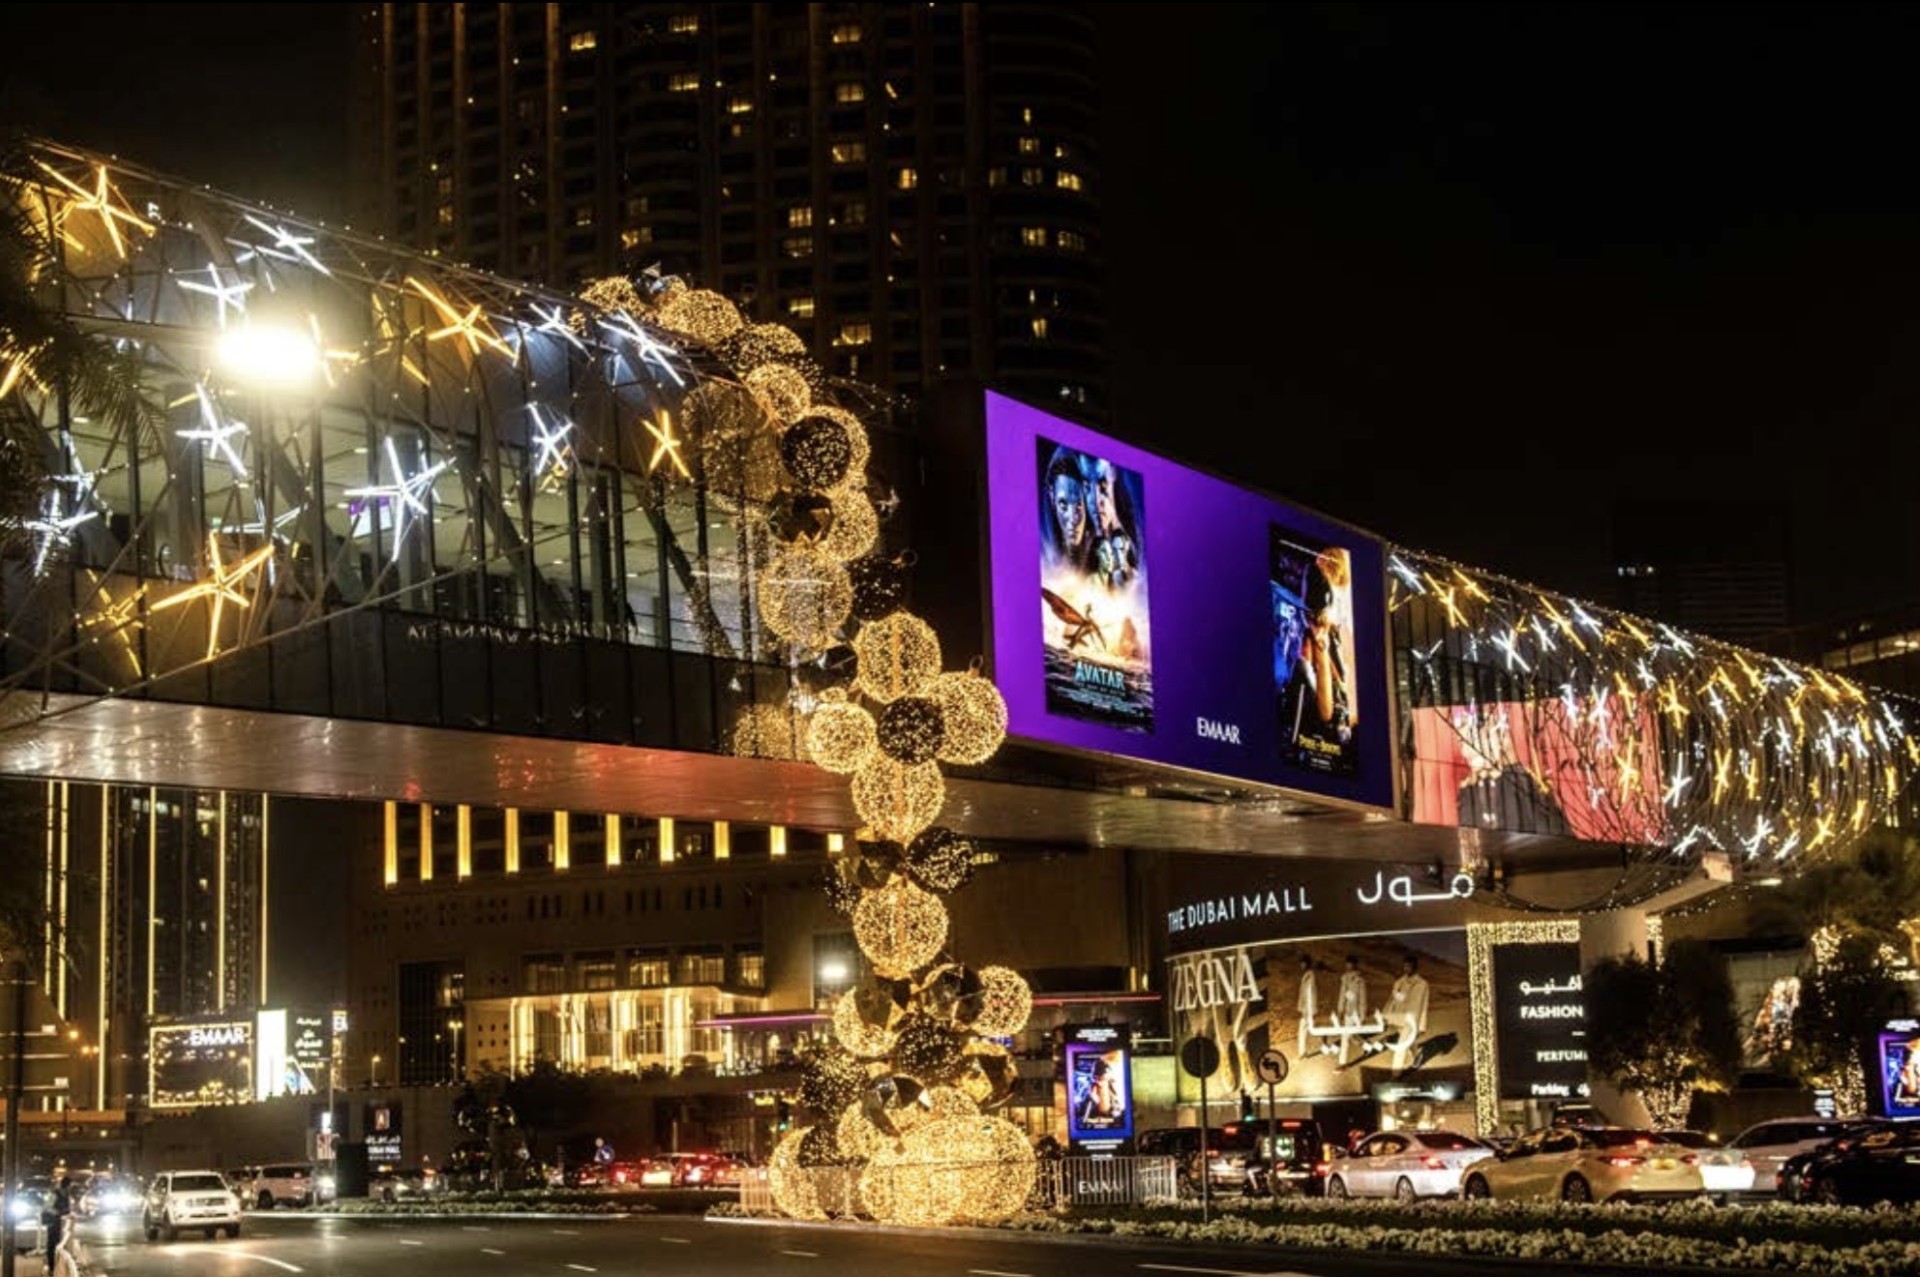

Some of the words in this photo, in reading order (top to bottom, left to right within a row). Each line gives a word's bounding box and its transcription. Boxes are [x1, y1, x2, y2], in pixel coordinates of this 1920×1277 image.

[1074, 660, 1125, 691] AVATAR
[1196, 716, 1241, 745] EMAAR
[1357, 870, 1474, 907] مول
[1168, 907, 1185, 932] THE
[1187, 896, 1235, 928] DUBAI
[1242, 886, 1313, 918] MALL
[1172, 953, 1263, 1012] ZEGNA
[1520, 1005, 1583, 1019] FASHION
[191, 1027, 244, 1047] EMAAR
